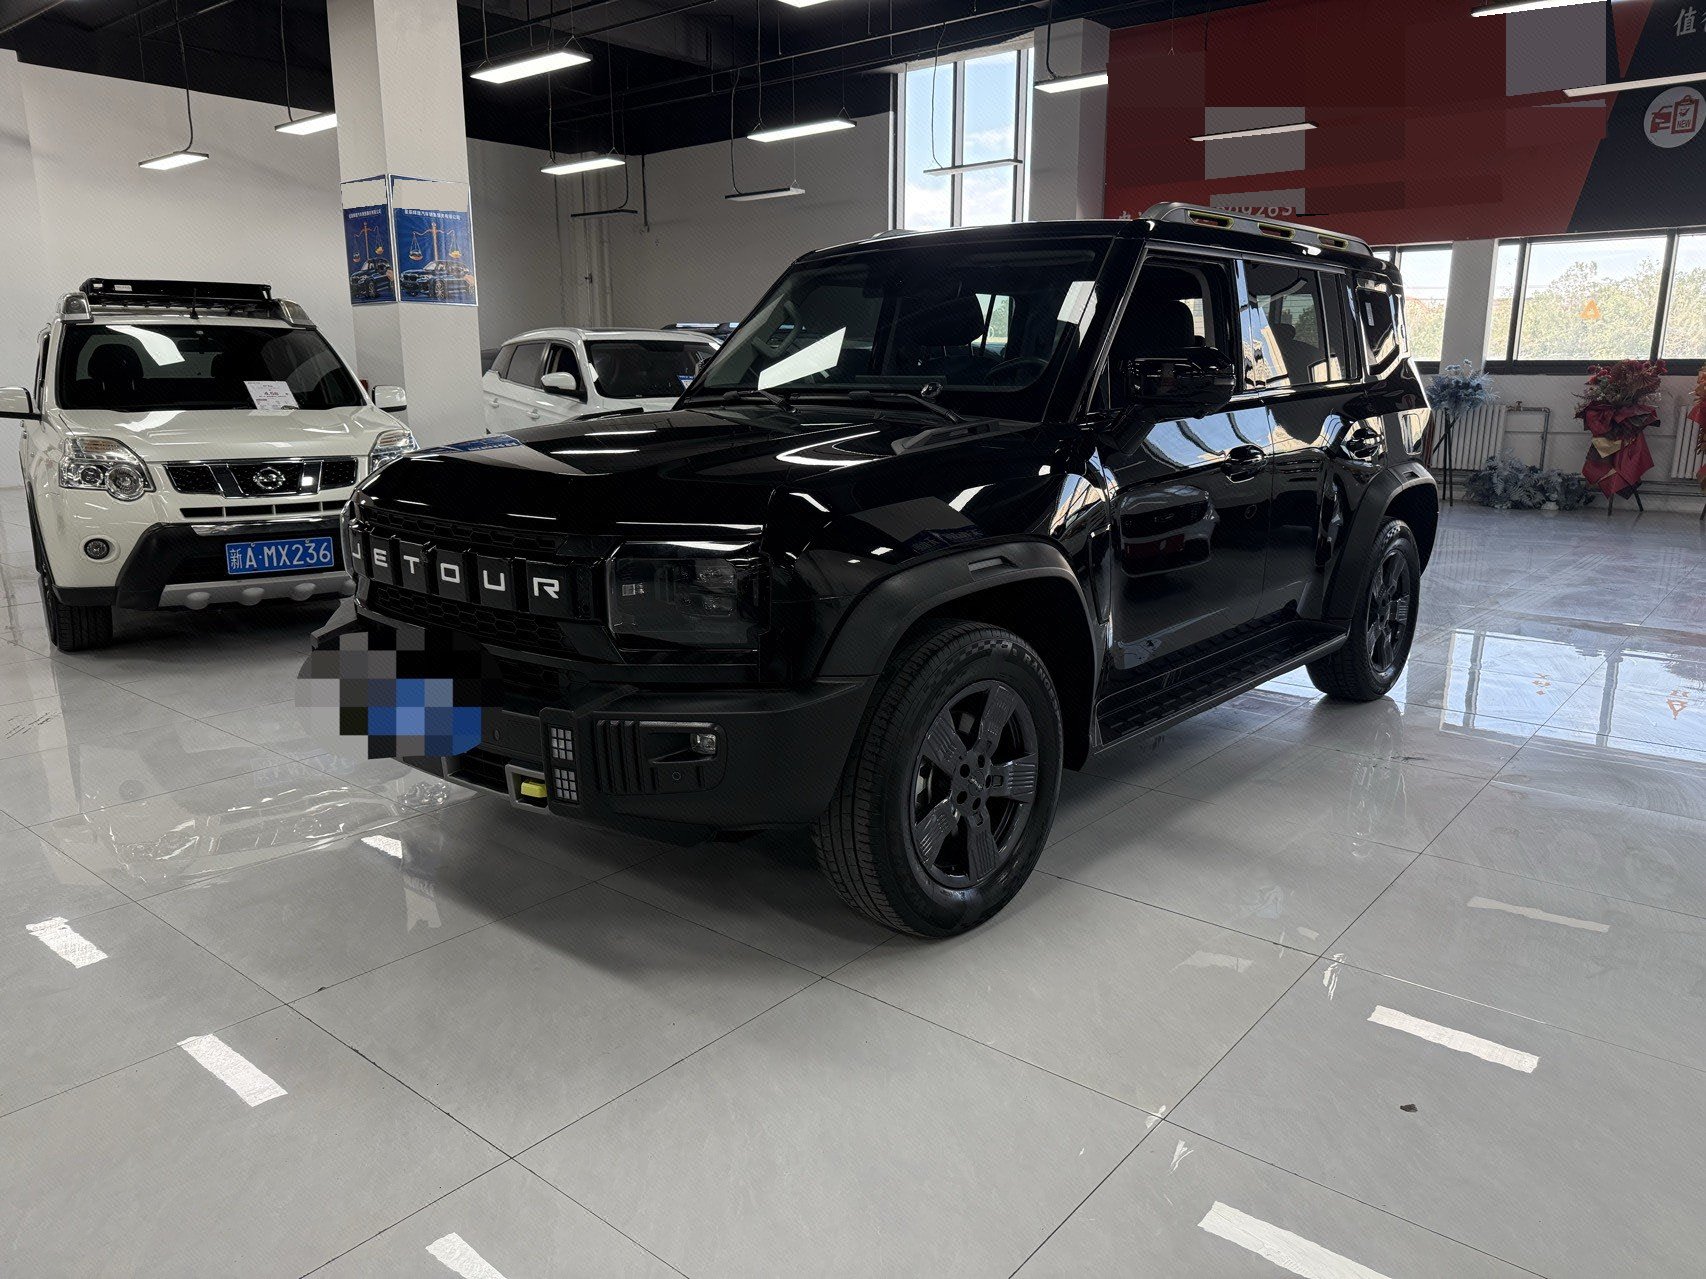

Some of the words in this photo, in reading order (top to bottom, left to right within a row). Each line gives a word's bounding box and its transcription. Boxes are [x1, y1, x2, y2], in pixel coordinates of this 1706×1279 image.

[1673, 6, 1706, 37] 值
[1676, 119, 1692, 129] NEW
[352, 543, 560, 599] JETOUR
